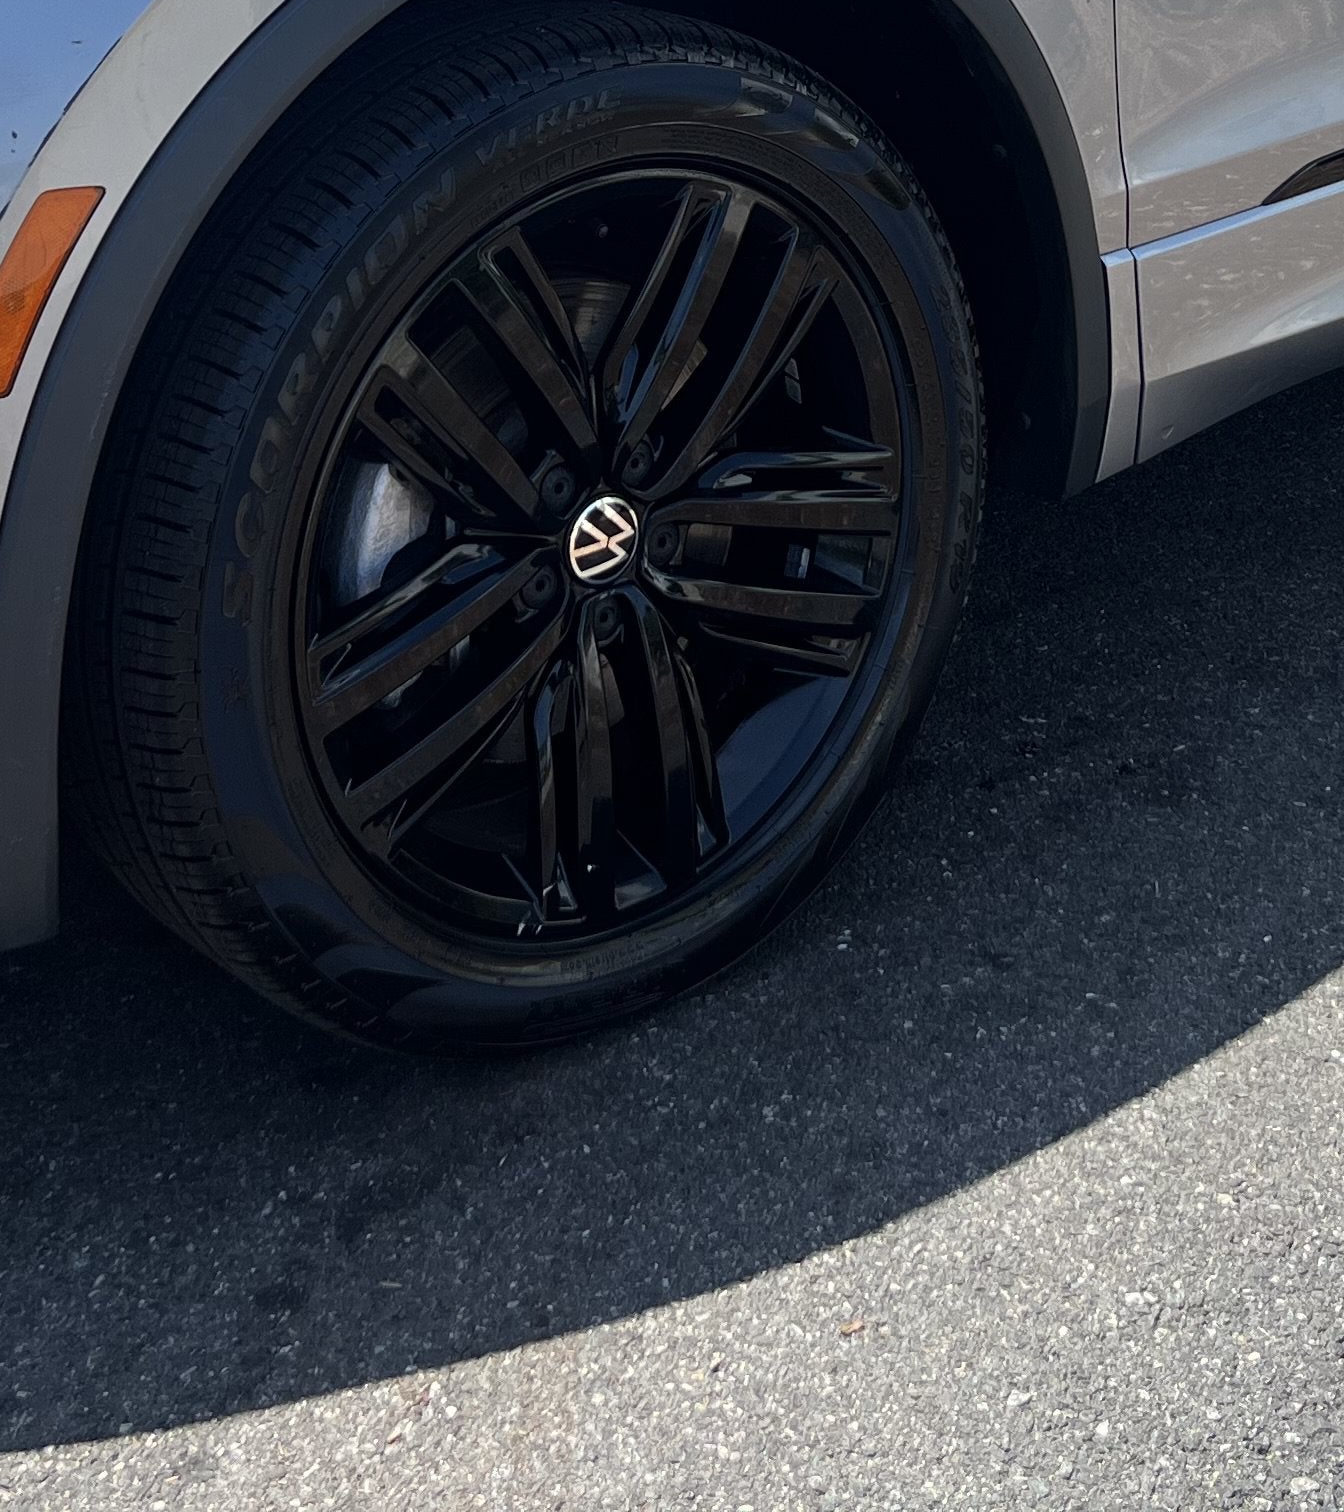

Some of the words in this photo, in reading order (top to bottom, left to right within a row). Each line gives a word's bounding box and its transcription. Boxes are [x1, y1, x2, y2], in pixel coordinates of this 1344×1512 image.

[223, 166, 457, 626] SCORPION
[474, 85, 624, 167] VERDE
[570, 497, 638, 584] VW
